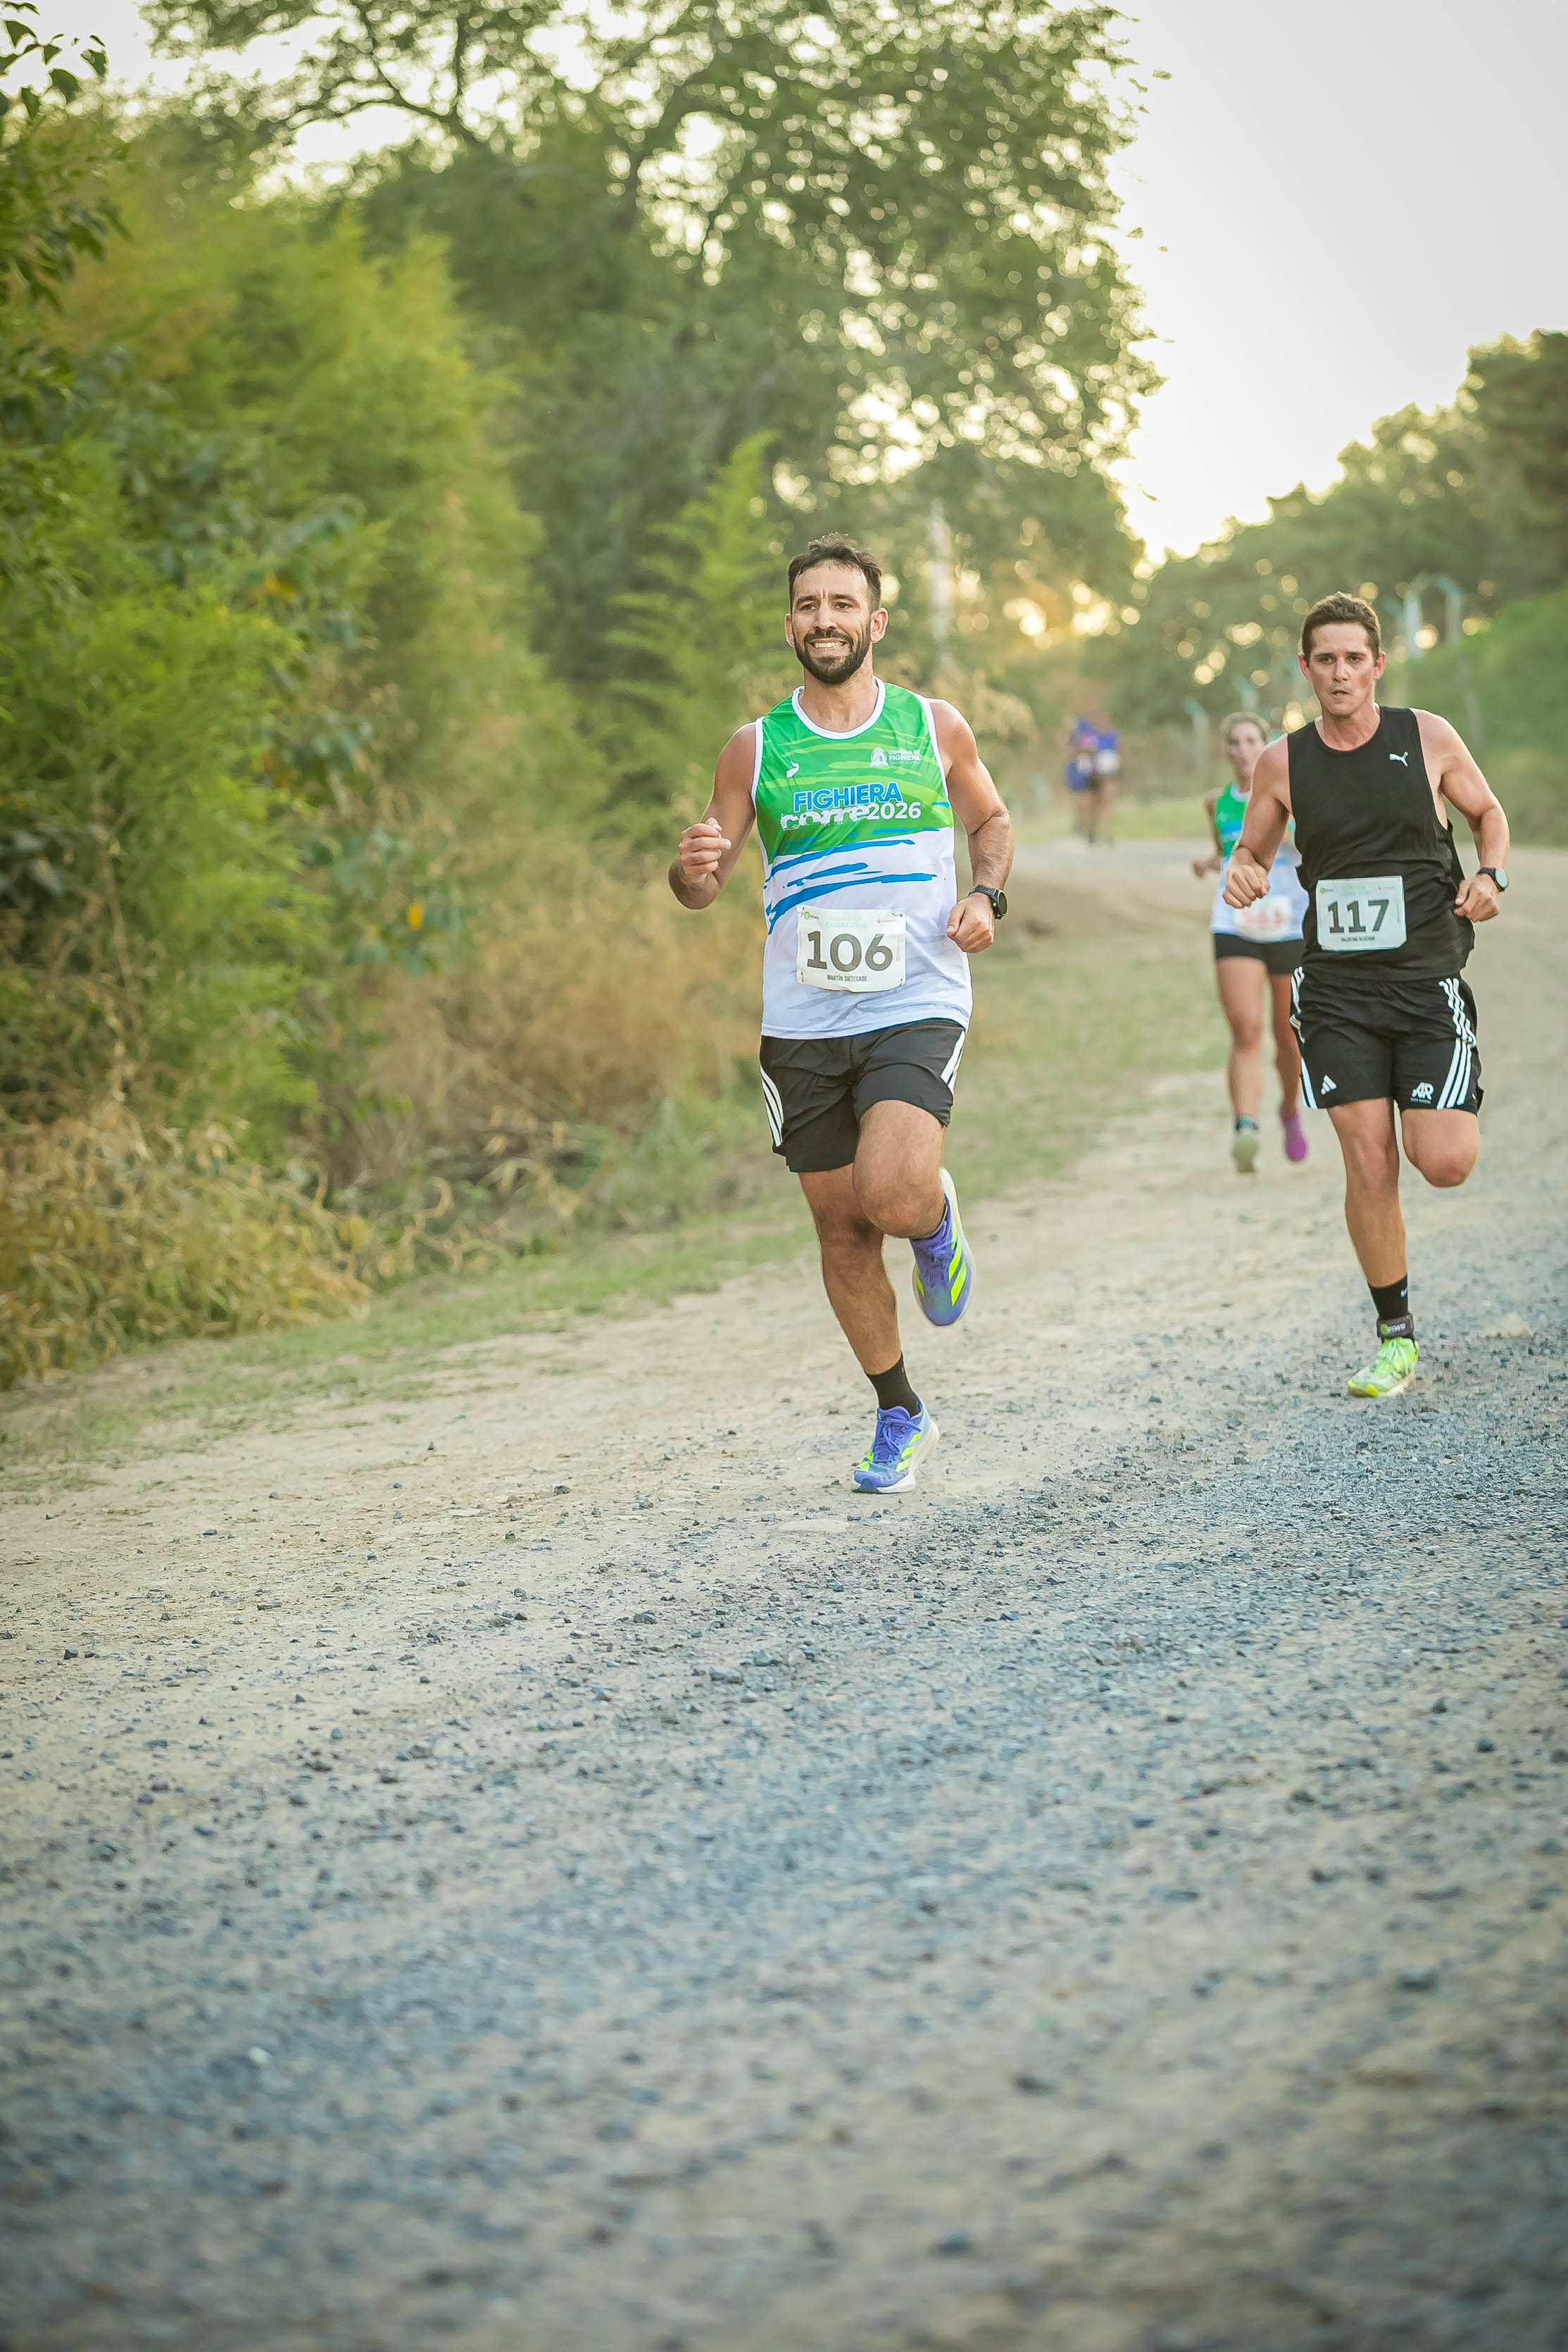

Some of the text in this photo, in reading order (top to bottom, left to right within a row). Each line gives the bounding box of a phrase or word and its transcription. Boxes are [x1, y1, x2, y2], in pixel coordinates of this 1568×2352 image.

[794, 782, 903, 813] FIGHIERA
[1328, 898, 1389, 933] 117
[807, 930, 893, 972] 106
